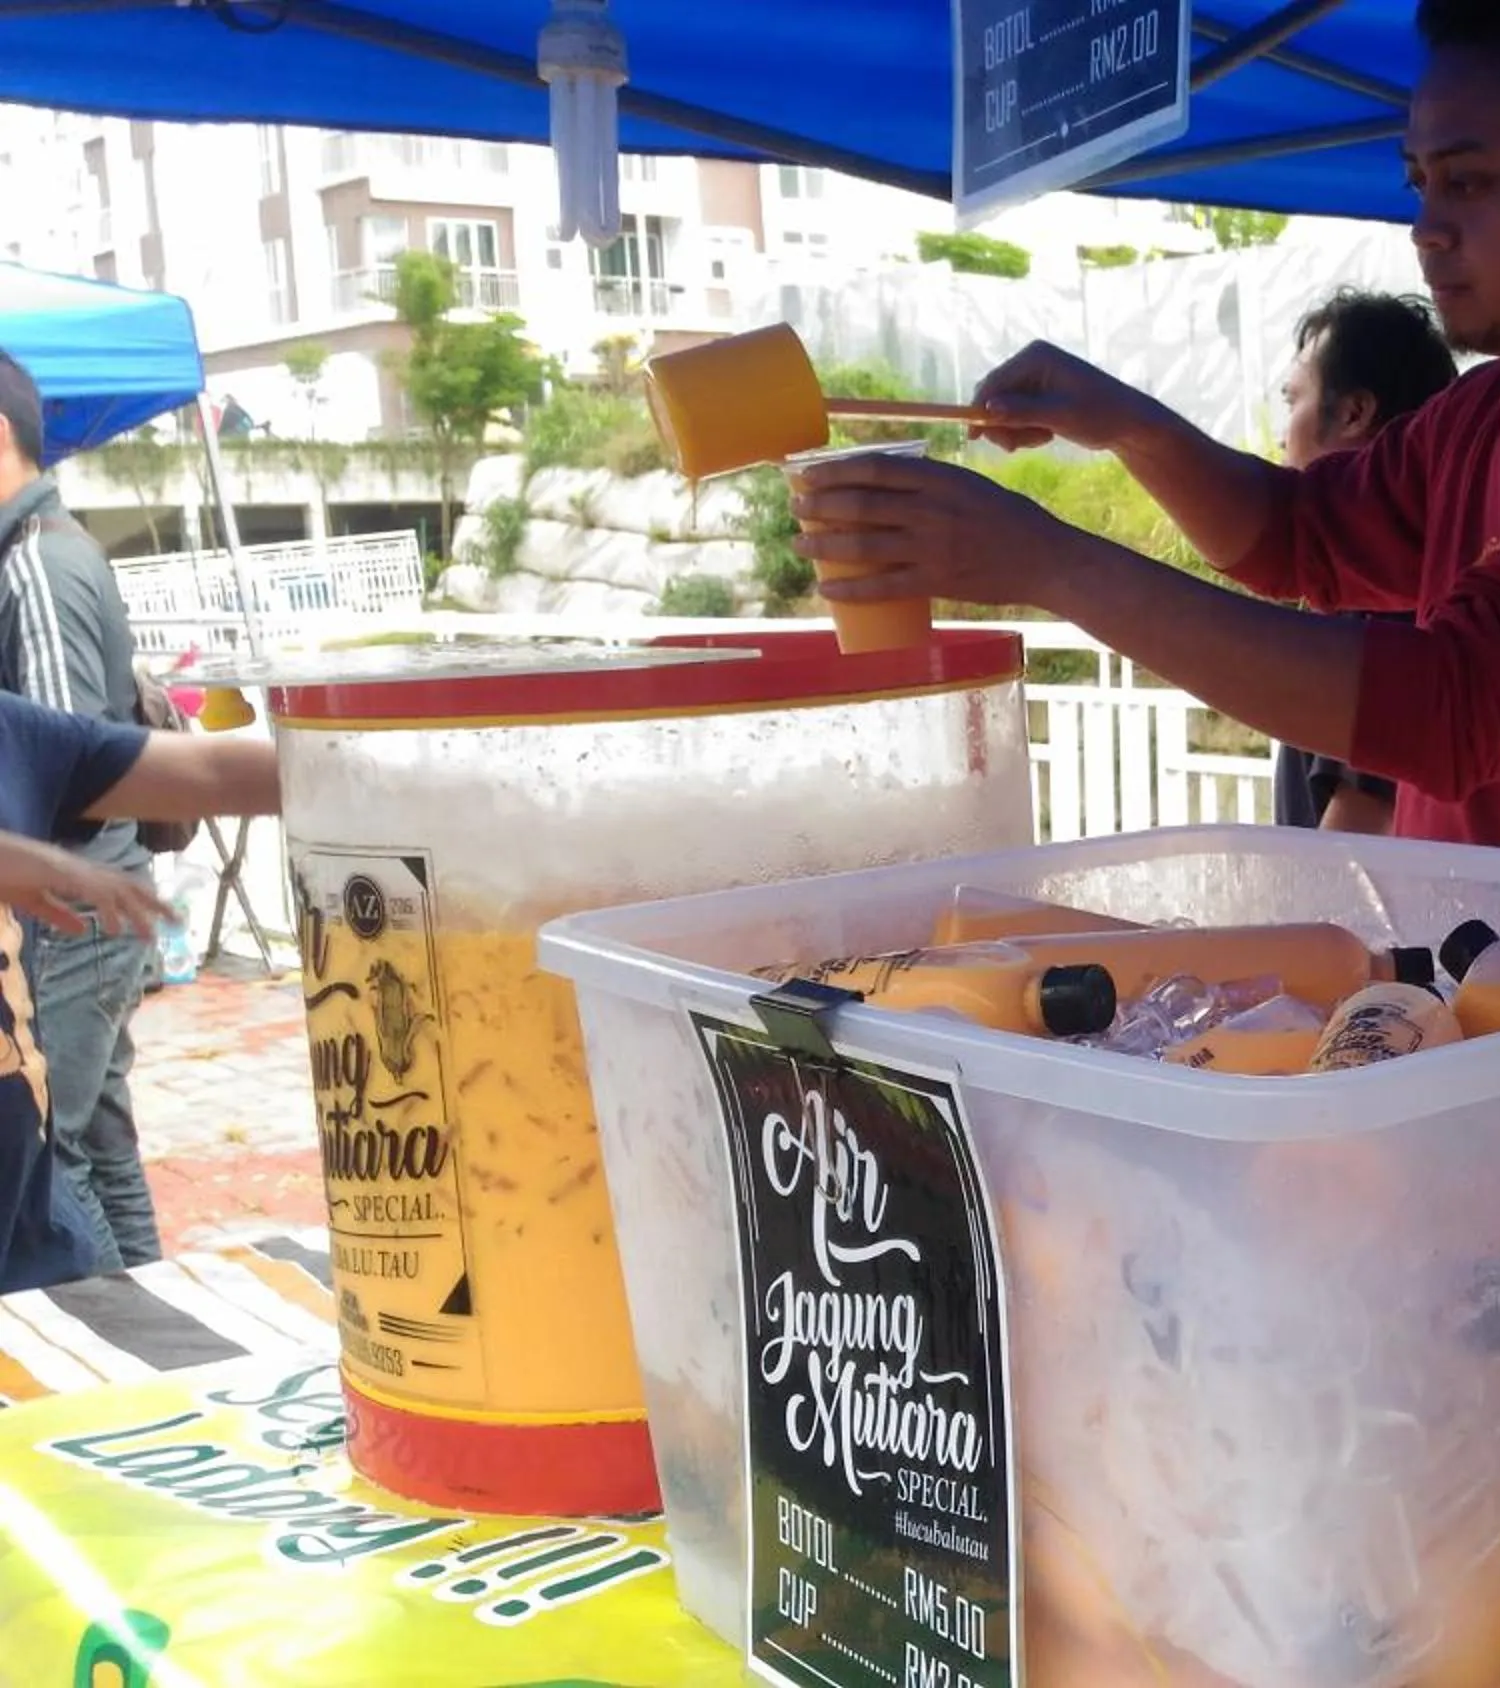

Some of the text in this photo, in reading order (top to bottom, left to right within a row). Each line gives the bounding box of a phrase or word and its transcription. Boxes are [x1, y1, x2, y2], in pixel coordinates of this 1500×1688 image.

[984, 7, 1034, 71] BOTOL
[985, 9, 1159, 133] CUP RM2.00
[762, 1089, 890, 1286] Air
[762, 1271, 923, 1388] Jagung
[786, 1352, 985, 1496] Mutiara
[894, 1510, 989, 1561] #lucubalutau
[897, 1467, 989, 1523] SPECIAL.
[777, 1495, 986, 1660] BOTOL RM5.00
[778, 1566, 818, 1630] CUP
